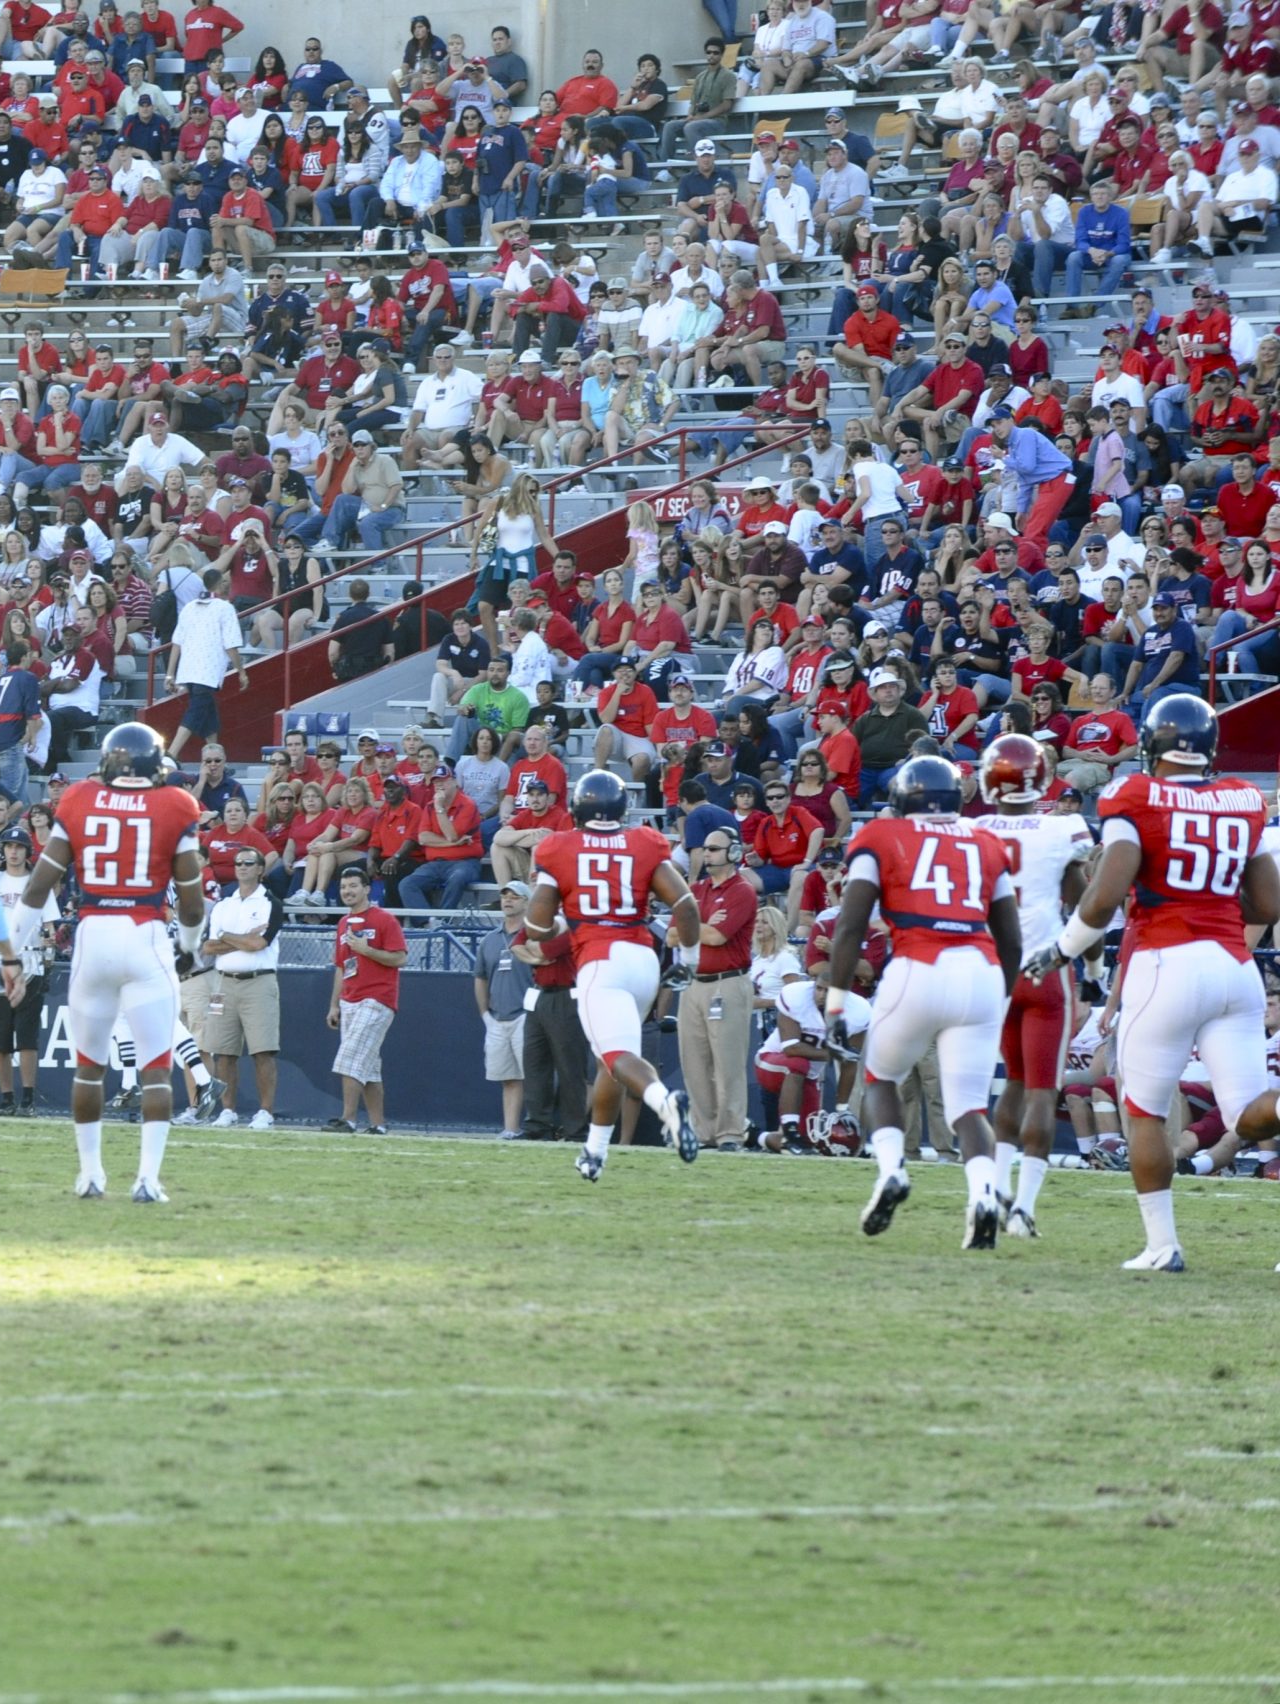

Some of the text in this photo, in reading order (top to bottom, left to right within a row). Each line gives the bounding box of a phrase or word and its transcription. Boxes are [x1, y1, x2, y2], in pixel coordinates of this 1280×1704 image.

[668, 498, 689, 517] SEC
[793, 666, 815, 692] 48
[82, 815, 154, 888] 21
[582, 833, 627, 849] YOUNG
[1166, 811, 1250, 896] 58
[577, 853, 637, 916] 51
[910, 837, 984, 911] 41
